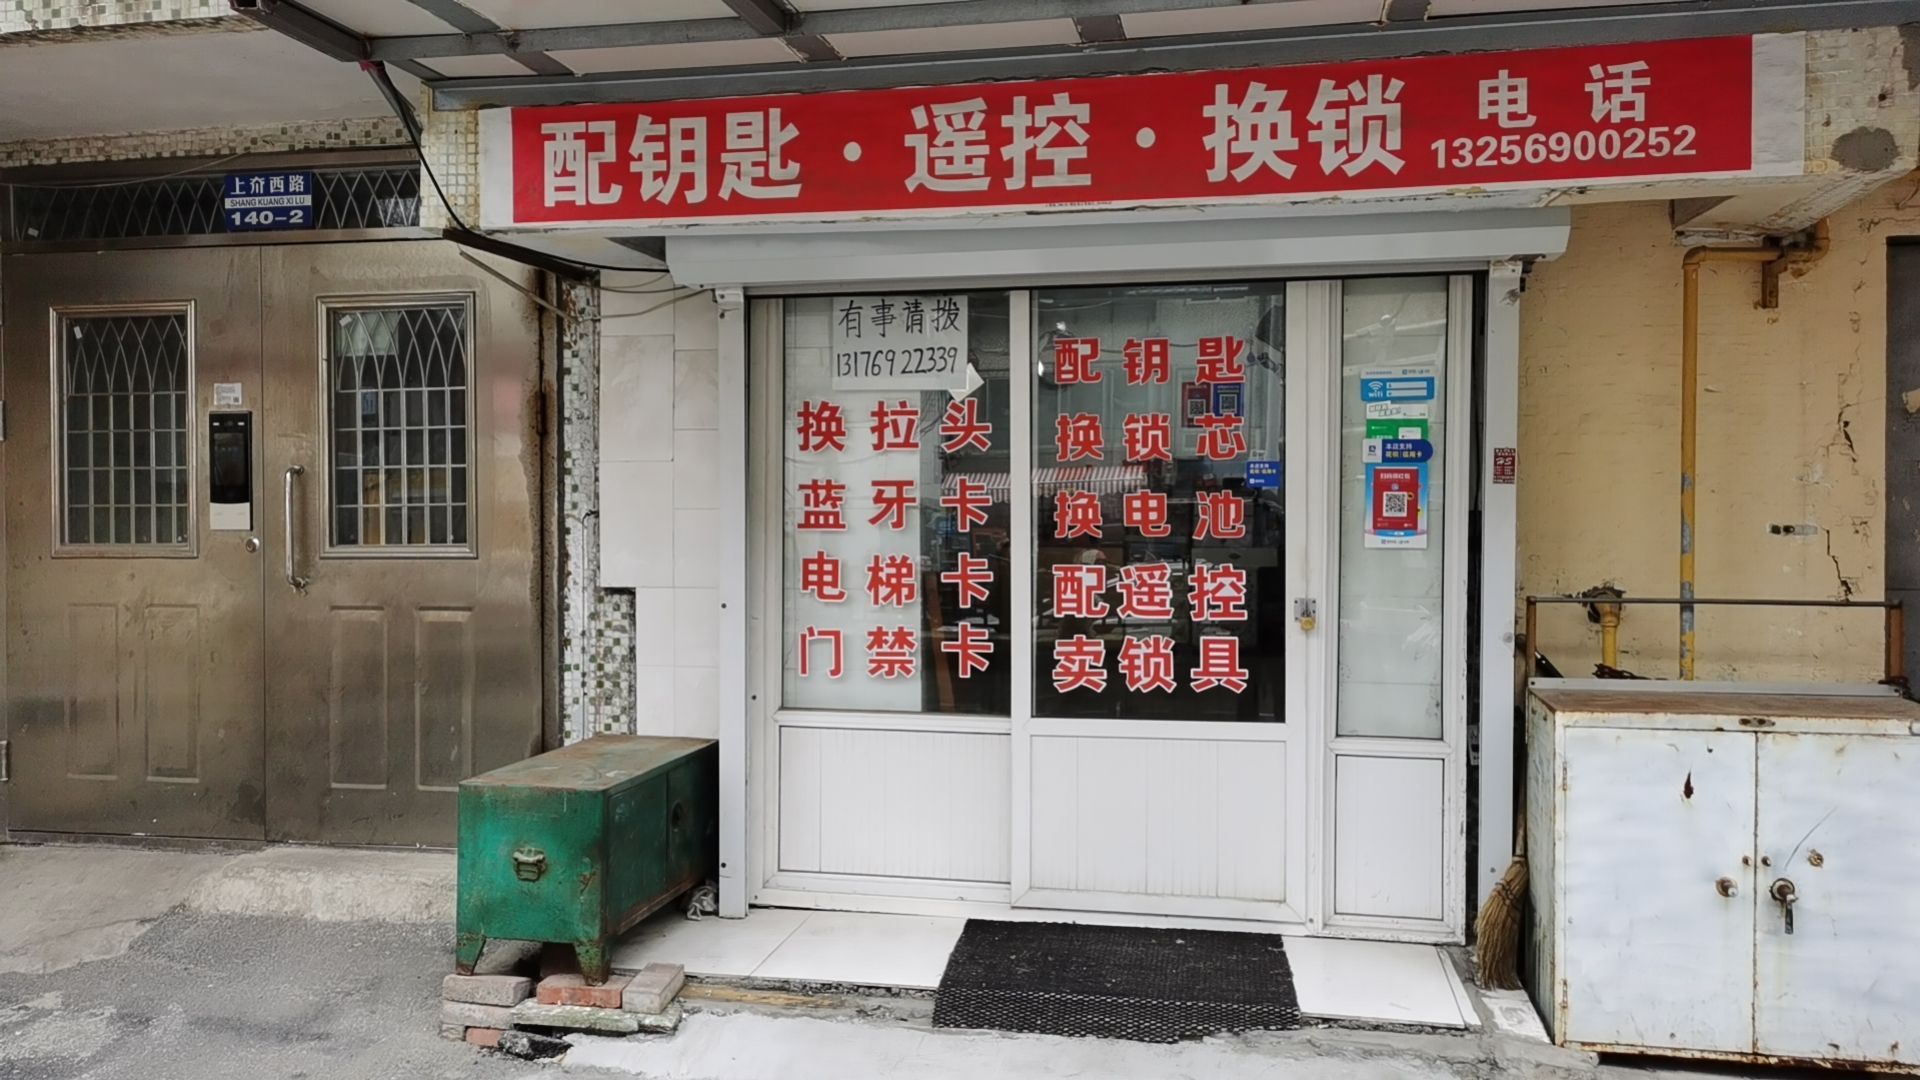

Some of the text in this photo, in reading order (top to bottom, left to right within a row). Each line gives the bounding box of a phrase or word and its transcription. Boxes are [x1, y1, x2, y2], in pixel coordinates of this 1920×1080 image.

[1477, 60, 1651, 129] 电话
[1430, 124, 1697, 169] 13256900252
[230, 196, 305, 207] SHANG KUANG XI LU
[231, 209, 304, 226] 140-2
[838, 297, 961, 338] 有事请拨
[1054, 336, 1245, 385] 配钥匙
[796, 398, 992, 454] 换拉头
[1056, 412, 1247, 462] 换锁芯
[796, 477, 992, 532] 蓝牙卡
[1053, 489, 1246, 540] 换电池
[800, 550, 994, 609] 电梯卡
[1052, 562, 1248, 622] 配遥控
[799, 622, 994, 679] 门禁卡
[1052, 635, 1250, 694] 卖锁具
